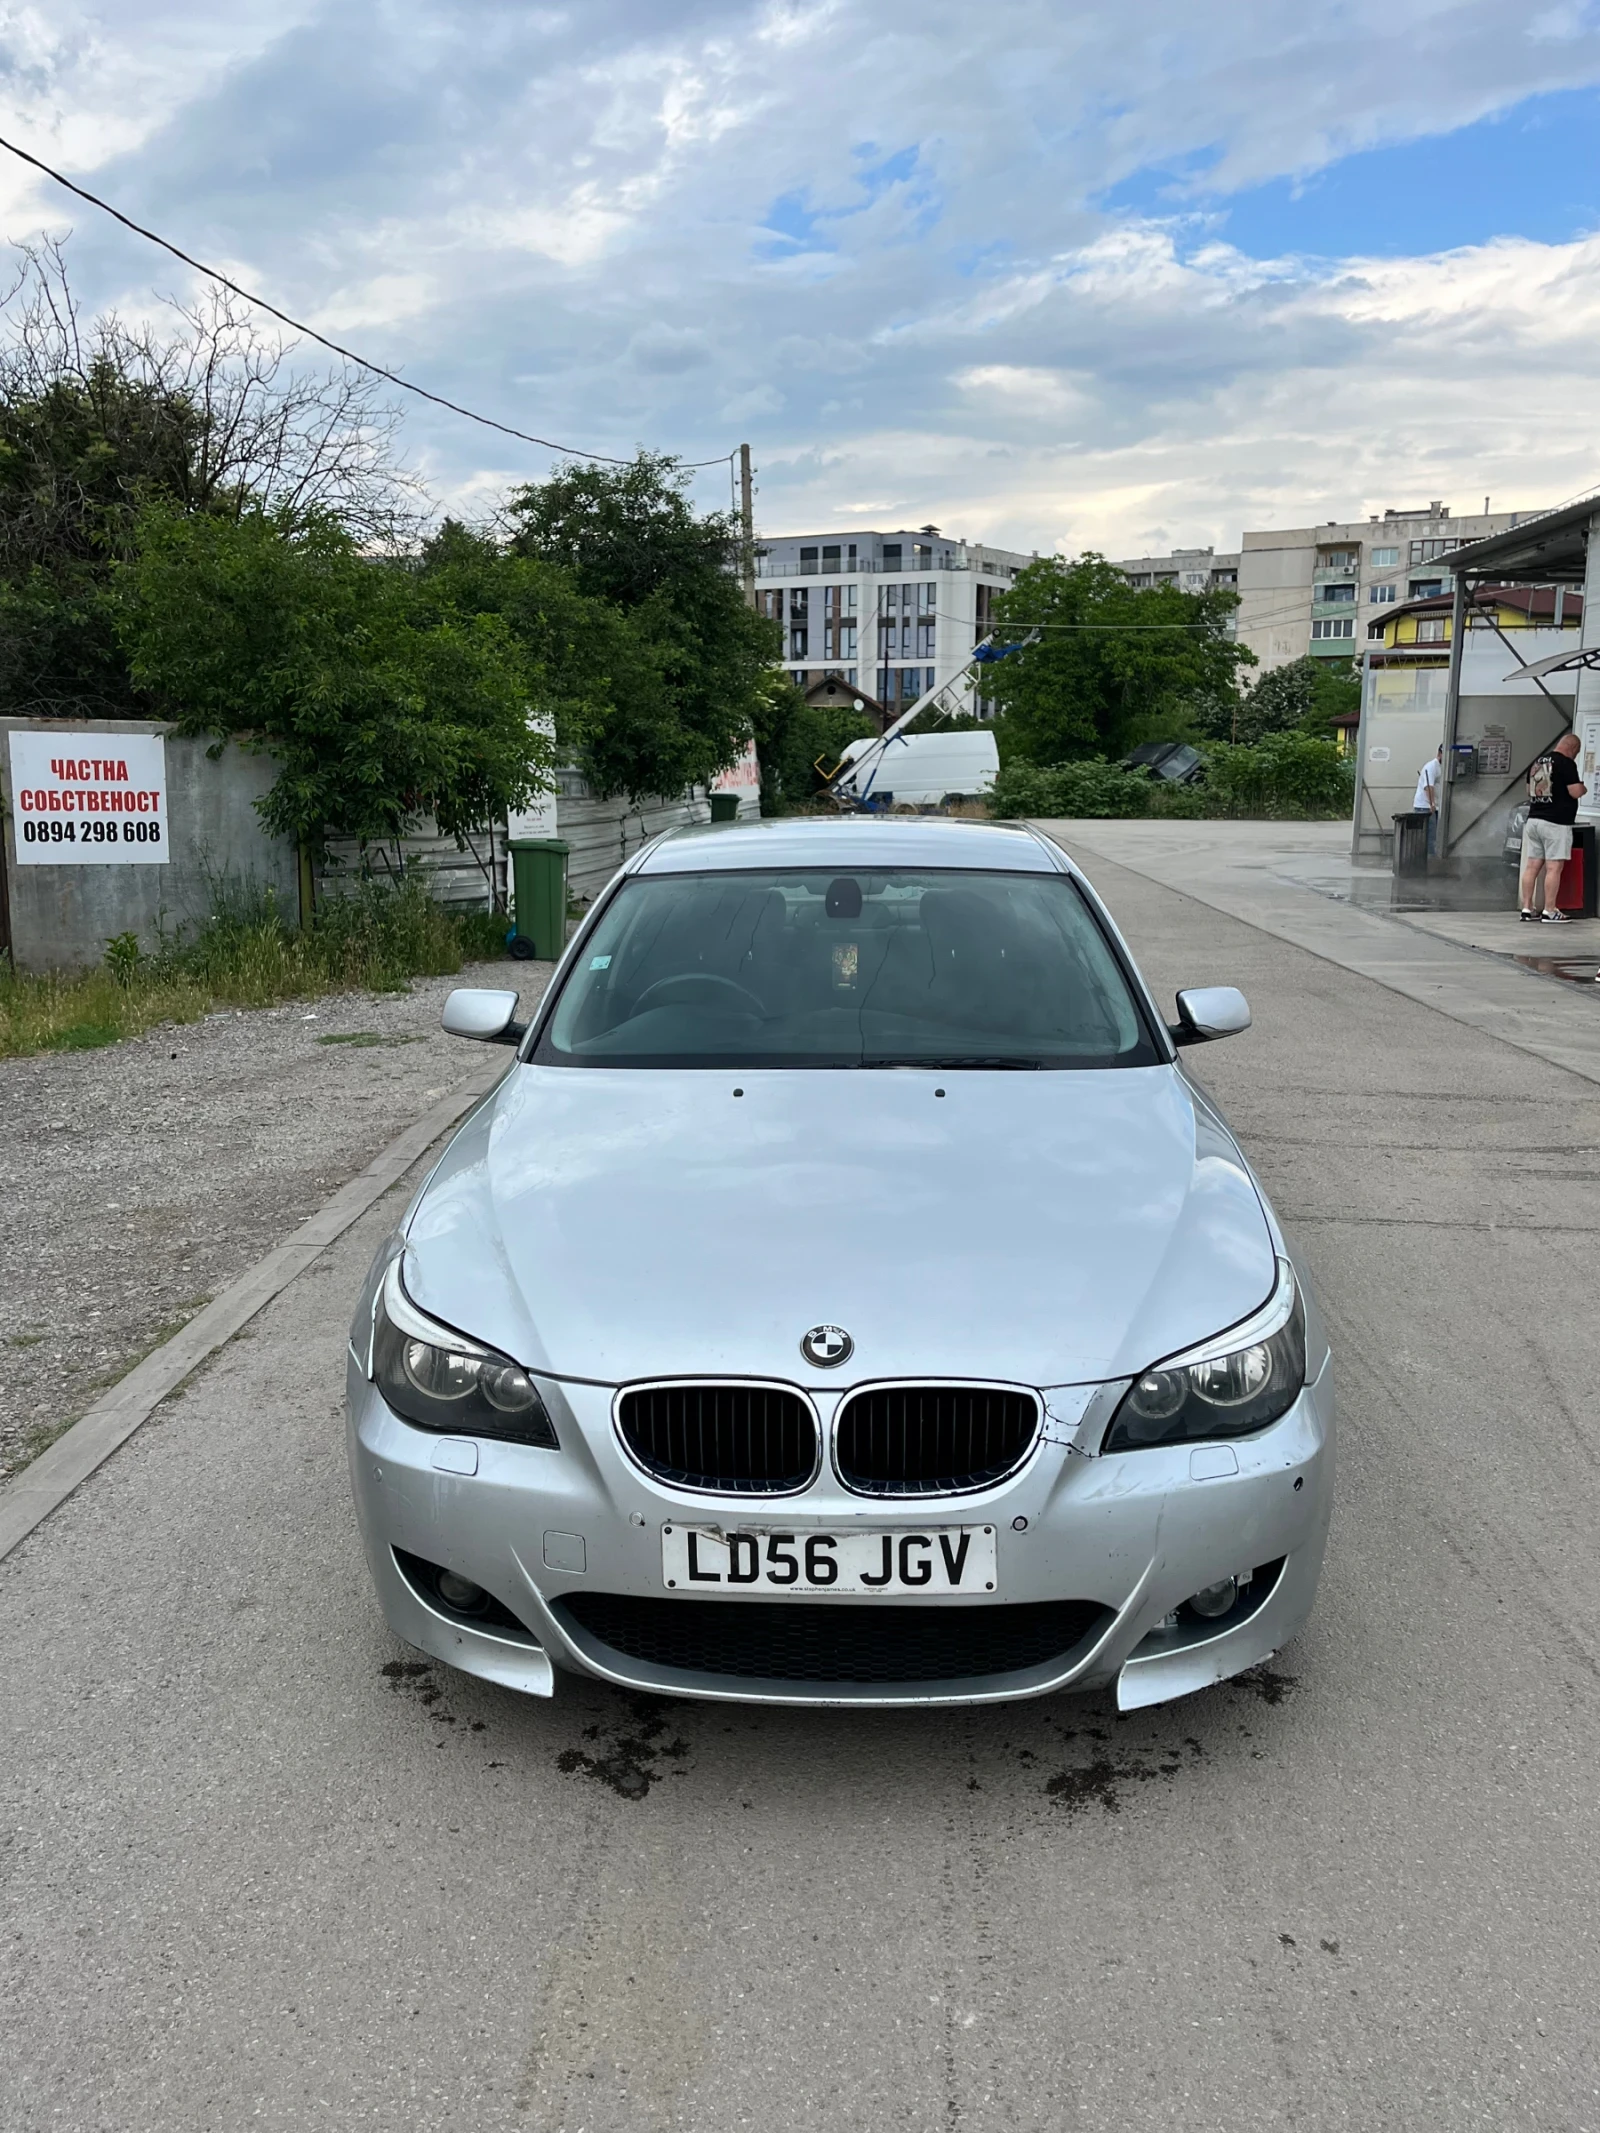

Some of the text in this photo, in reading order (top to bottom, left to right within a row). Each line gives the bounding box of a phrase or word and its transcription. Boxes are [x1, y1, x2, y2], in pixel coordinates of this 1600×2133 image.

[50, 759, 129, 781] ЧАСТНА
[20, 789, 160, 812] СОБСТВЕНОСТ
[23, 821, 161, 842] 0894 298 608
[808, 1326, 848, 1339] BMW
[687, 1532, 971, 1586] LD56 JGV
